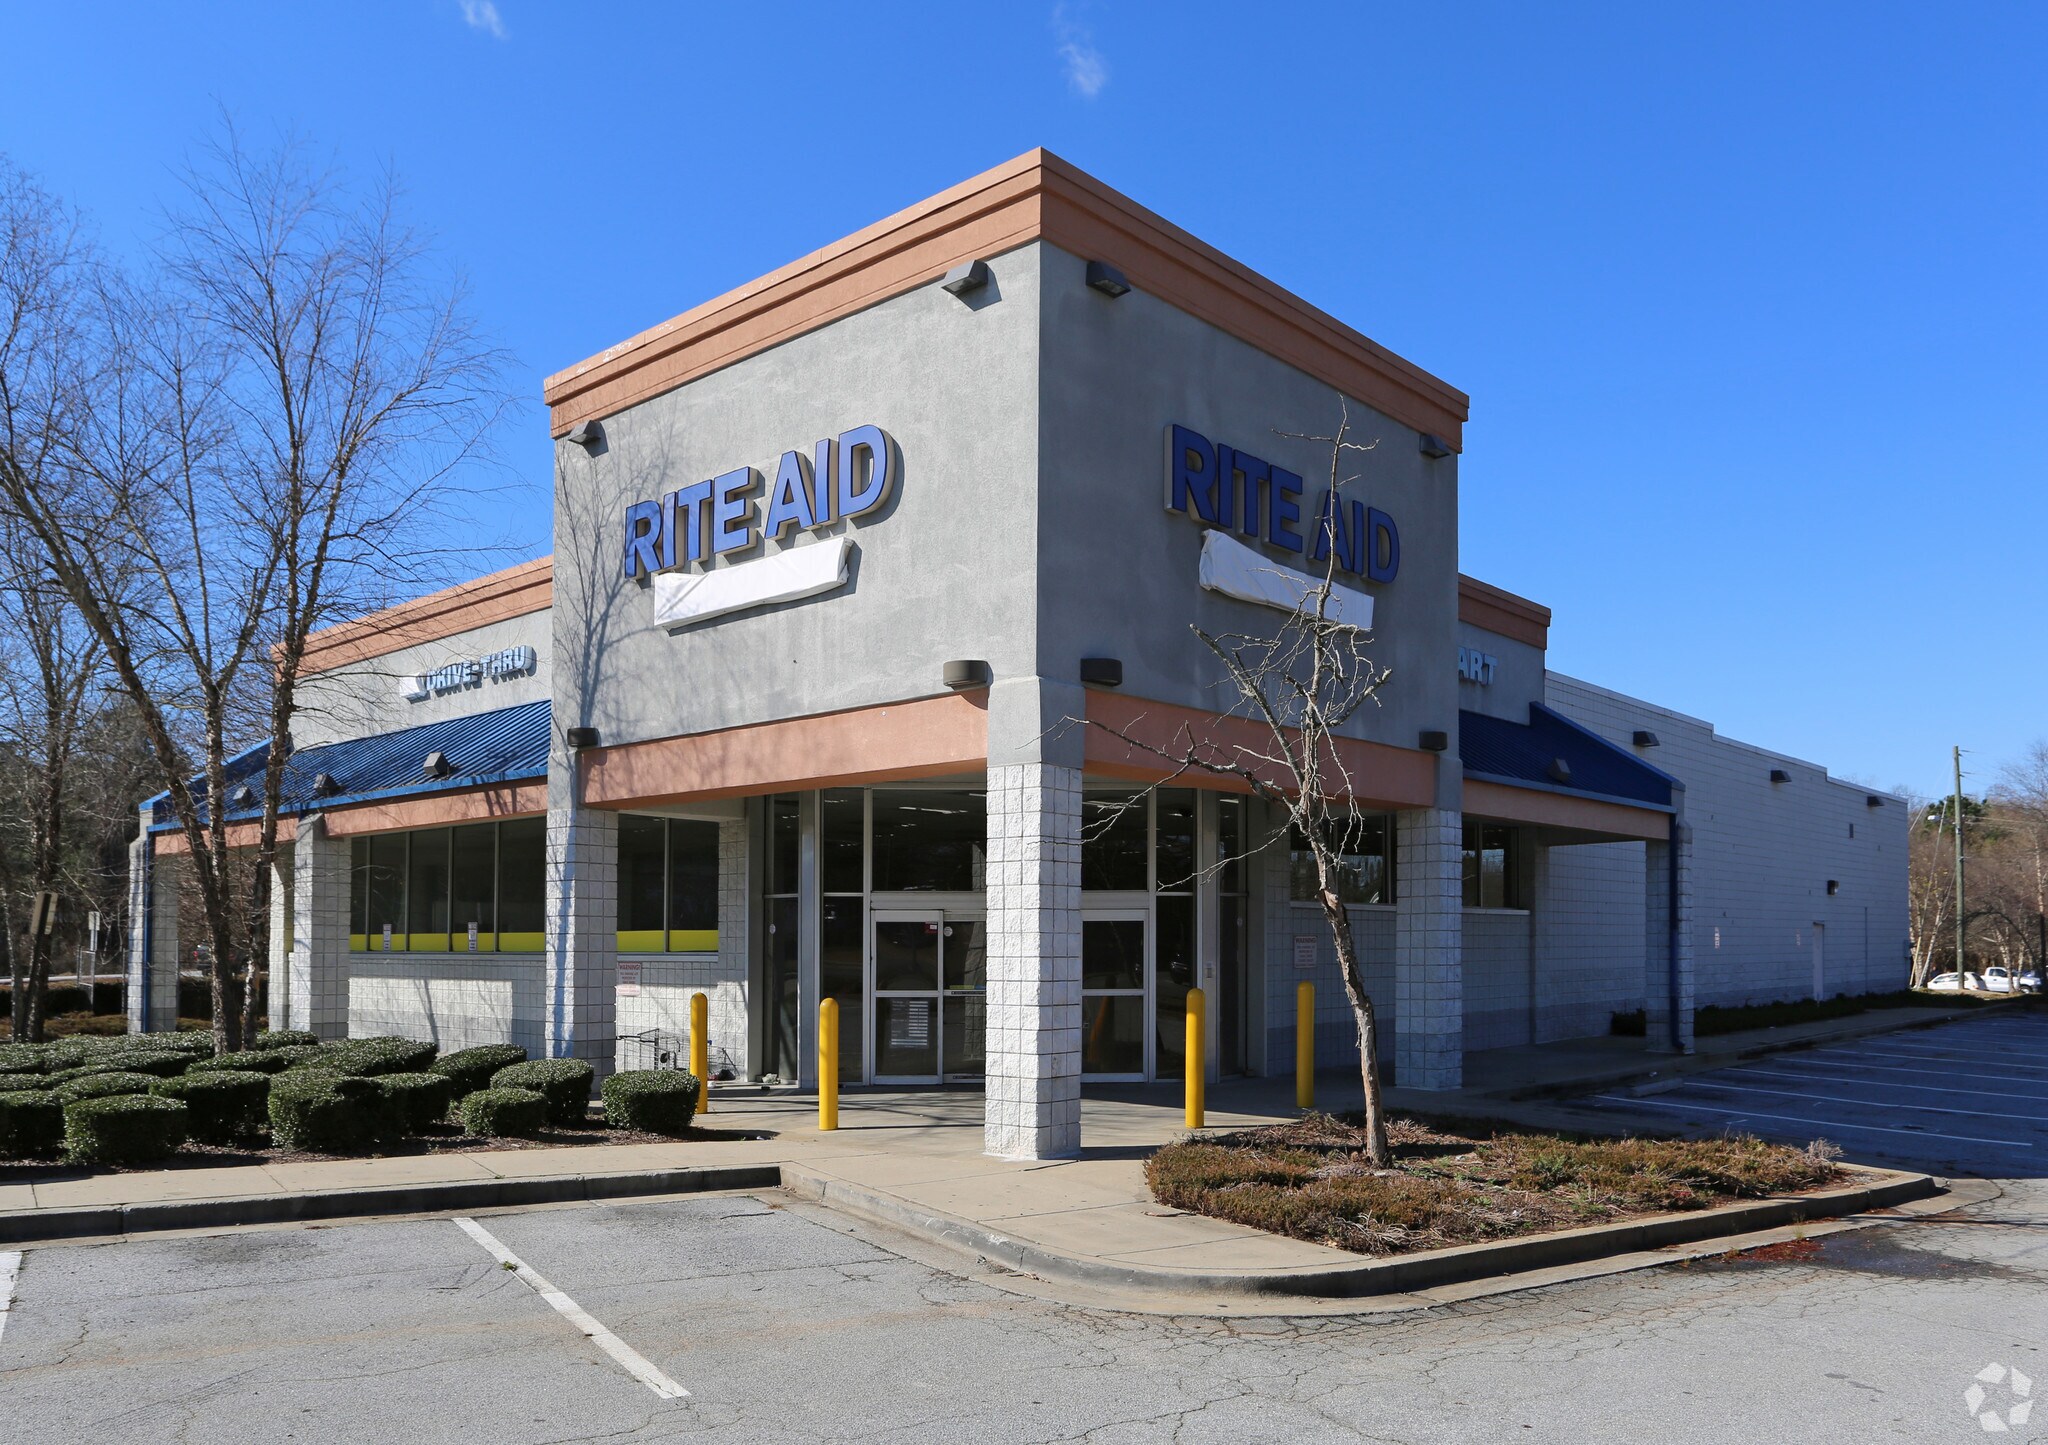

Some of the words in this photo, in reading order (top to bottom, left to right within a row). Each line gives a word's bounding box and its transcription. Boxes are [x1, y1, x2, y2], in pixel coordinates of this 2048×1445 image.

[625, 466, 755, 579] RITE
[764, 424, 893, 540] AID
[1166, 424, 1303, 553] RITE
[1310, 489, 1400, 584] AID
